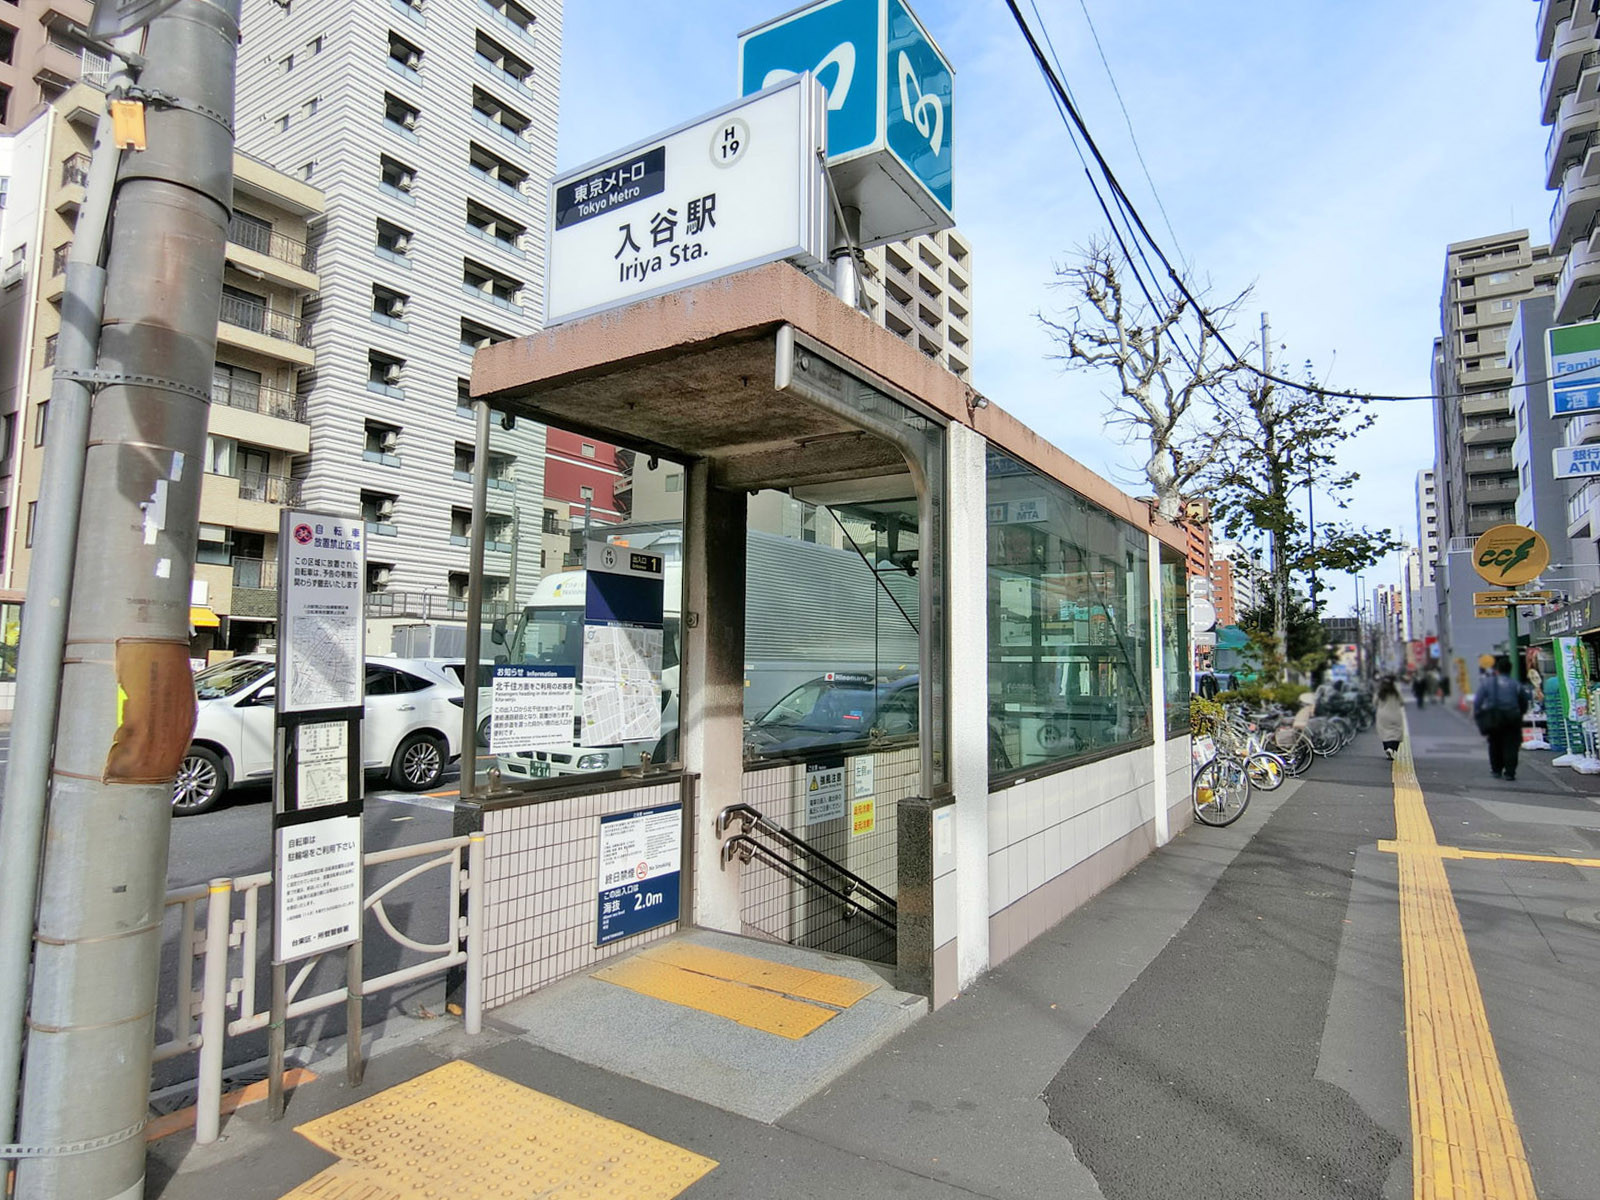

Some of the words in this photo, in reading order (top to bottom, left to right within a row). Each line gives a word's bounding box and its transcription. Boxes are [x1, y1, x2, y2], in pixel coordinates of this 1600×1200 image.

[724, 127, 735, 141] H
[720, 140, 739, 159] 19
[573, 161, 645, 204] 東京メトロ
[577, 198, 608, 217] Tokyo
[608, 185, 641, 207] Metro
[614, 193, 717, 259] 入谷駅
[619, 255, 662, 283] Iriya
[669, 245, 709, 268] Sta.
[1573, 448, 1600, 461] 銀行
[1569, 460, 1600, 474] ATM
[314, 538, 360, 550] 放置禁止区域
[605, 556, 614, 565] 19
[651, 558, 657, 571] 1
[497, 667, 524, 677] お知らせ
[495, 682, 573, 691] 北千住方面をご利用のお客様
[288, 835, 316, 848] 自転車は
[288, 842, 356, 862] 駐輪場をご利用下さい
[605, 868, 635, 885] 終日禁煙
[603, 884, 639, 900] この出入口は
[603, 900, 621, 914] 海抜
[633, 892, 662, 911] 2.0m
